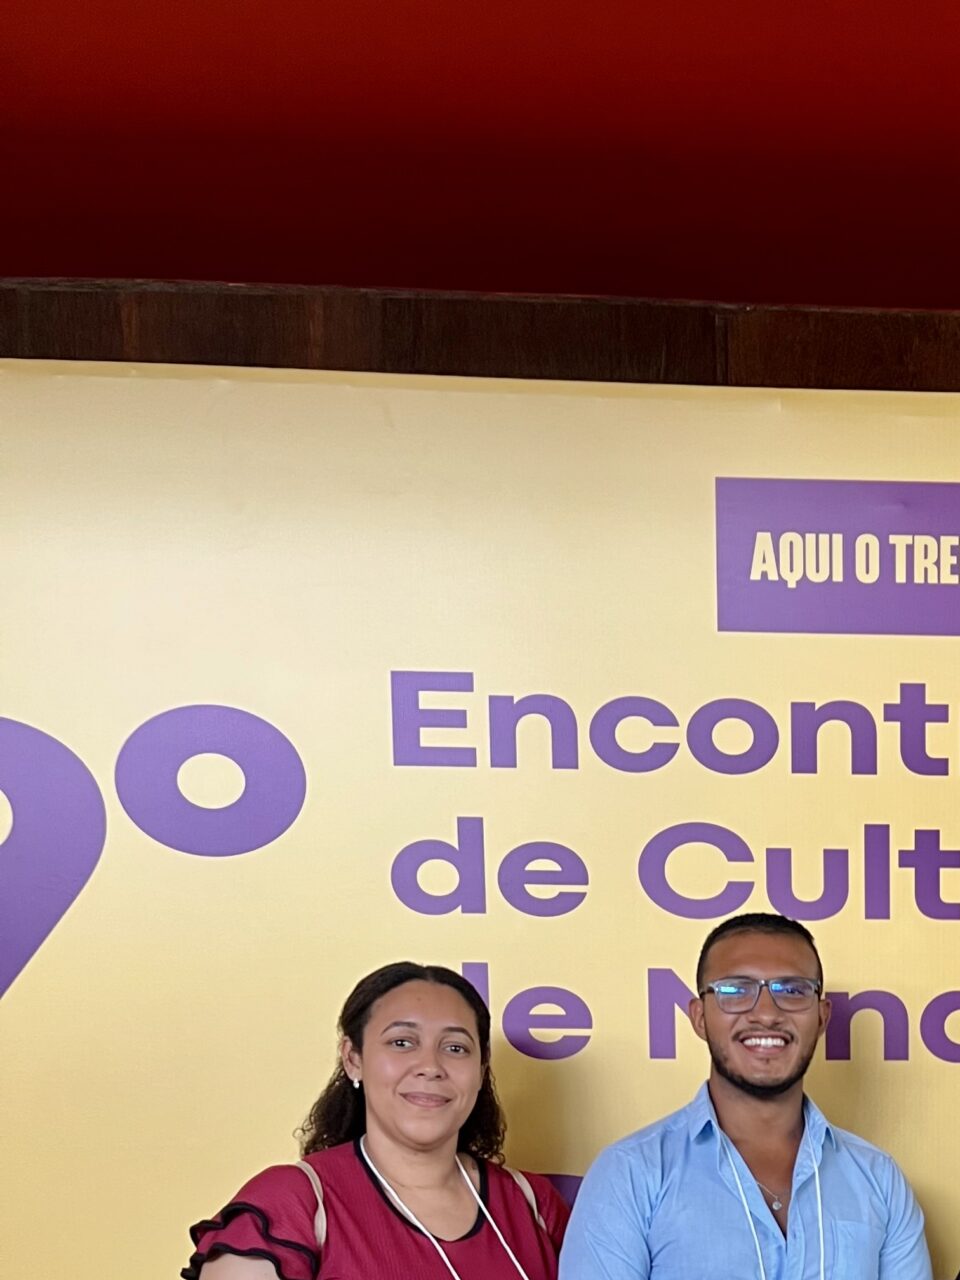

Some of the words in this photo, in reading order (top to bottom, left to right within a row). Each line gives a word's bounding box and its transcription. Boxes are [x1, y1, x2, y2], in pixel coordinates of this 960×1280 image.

[750, 531, 844, 588] AQUI
[855, 534, 880, 584] O
[390, 816, 590, 918] de
